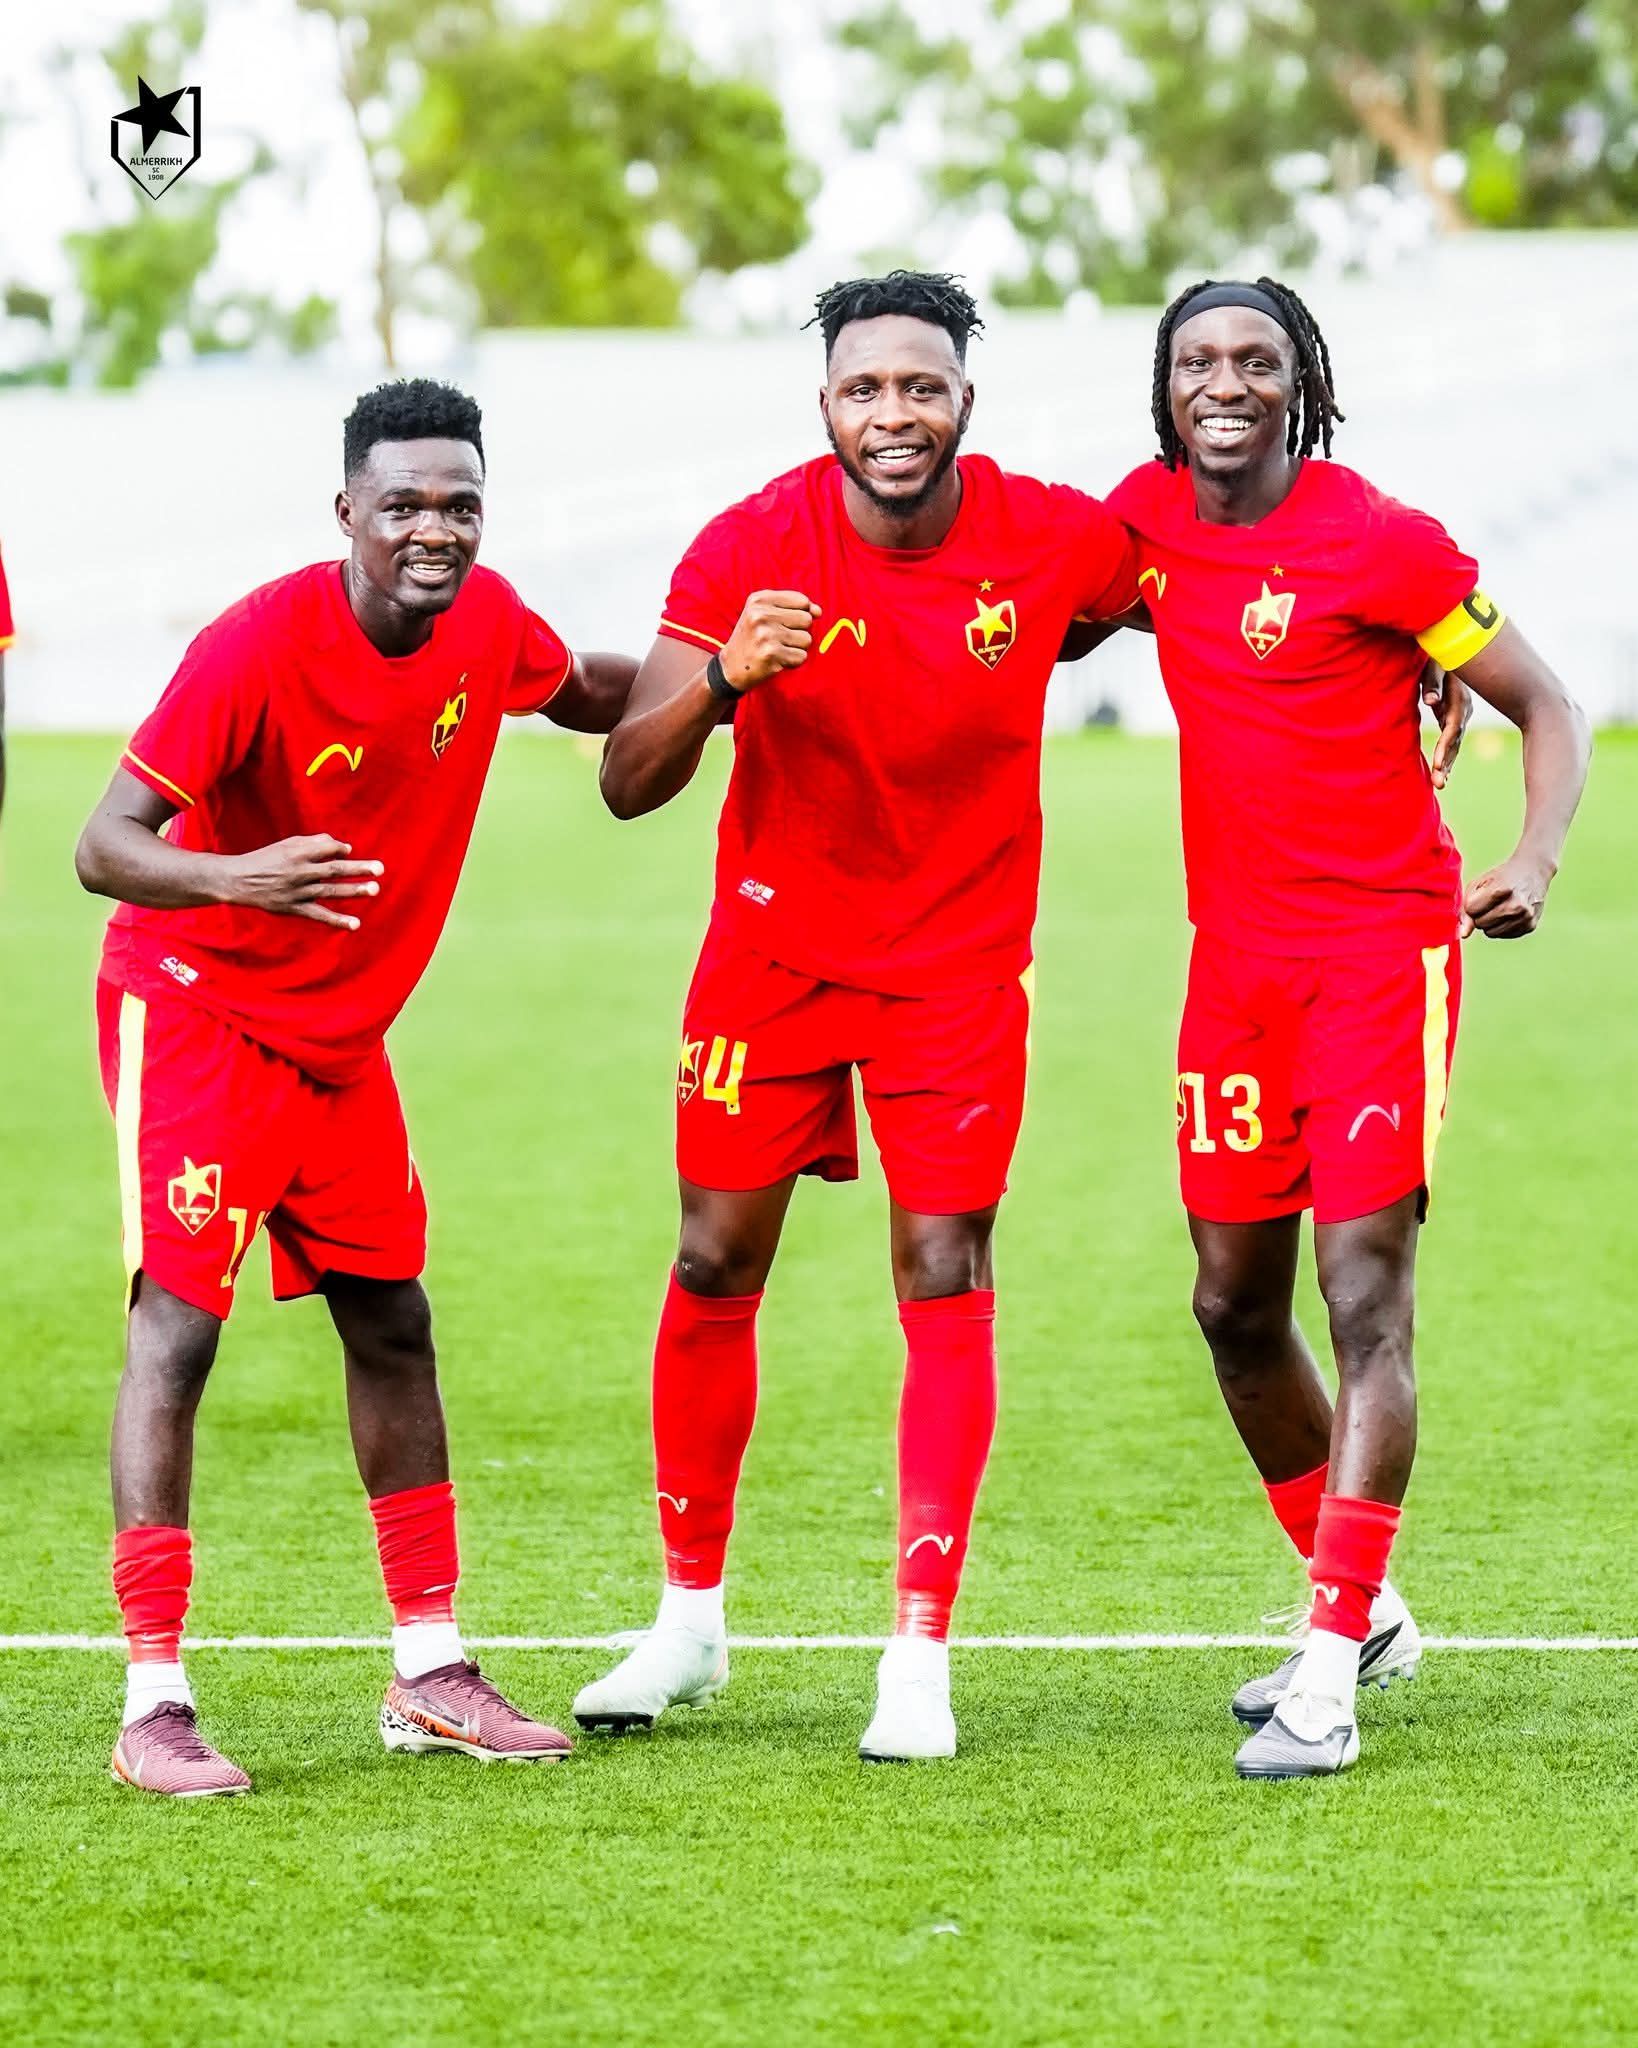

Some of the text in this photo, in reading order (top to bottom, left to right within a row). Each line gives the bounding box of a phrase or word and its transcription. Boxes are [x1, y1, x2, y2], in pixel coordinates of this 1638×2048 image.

[1462, 589, 1498, 630] C
[703, 1034, 748, 1115] 4
[1184, 1072, 1263, 1153] 13
[220, 1207, 270, 1289] 1
